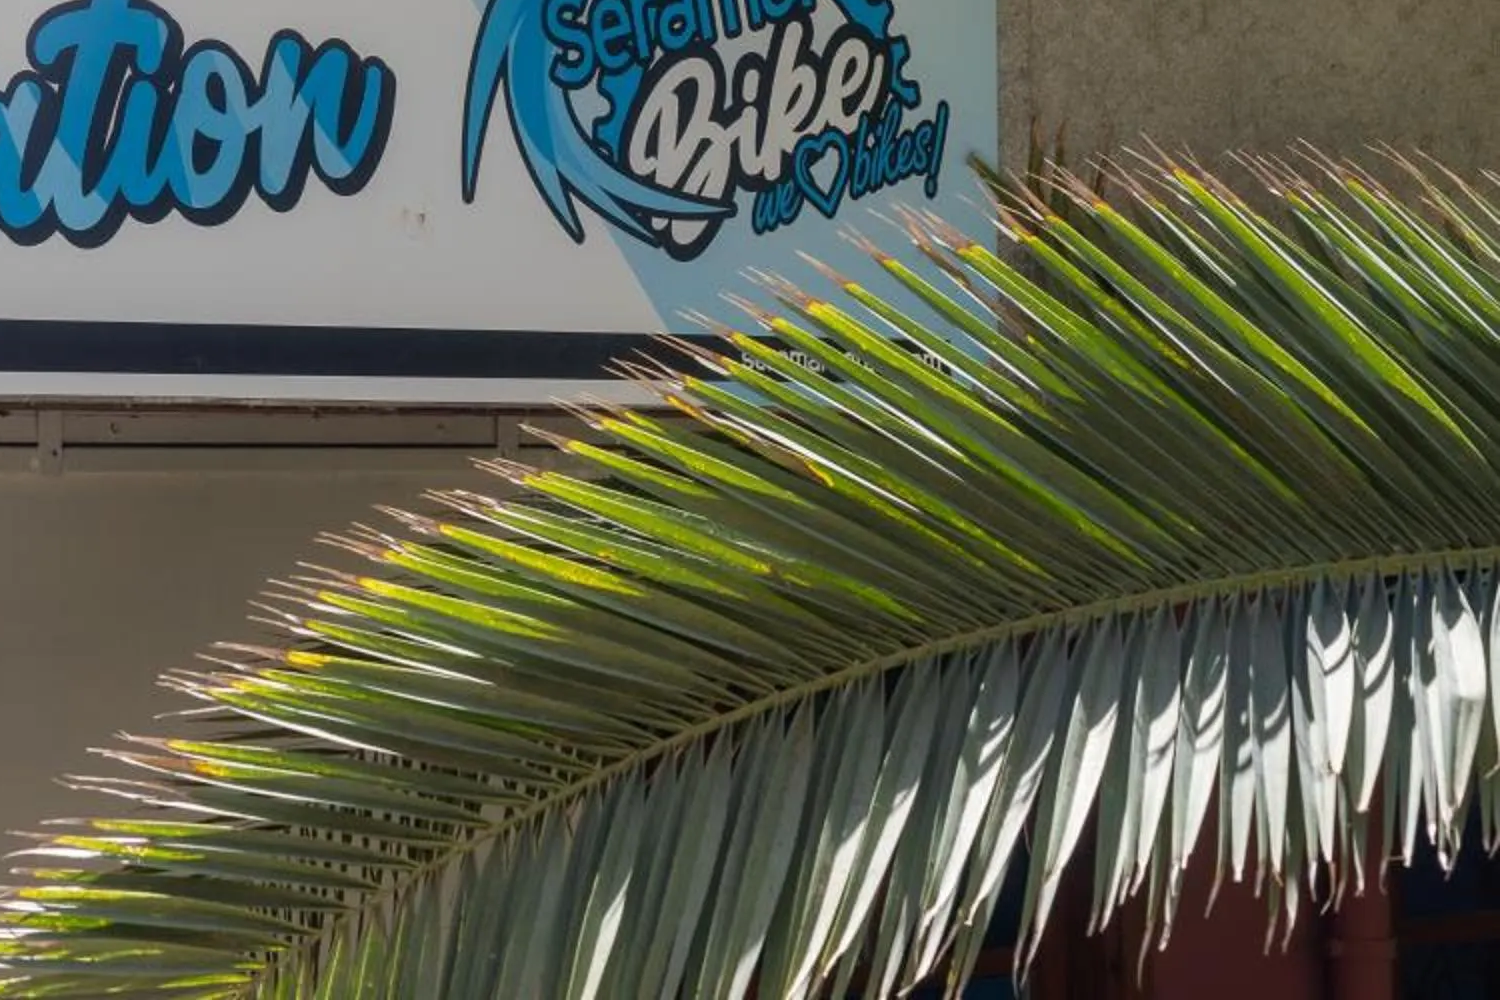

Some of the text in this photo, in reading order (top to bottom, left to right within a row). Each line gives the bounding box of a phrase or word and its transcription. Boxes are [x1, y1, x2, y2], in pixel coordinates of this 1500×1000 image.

[622, 16, 892, 262] Bike
[752, 97, 949, 236] we bikes!
